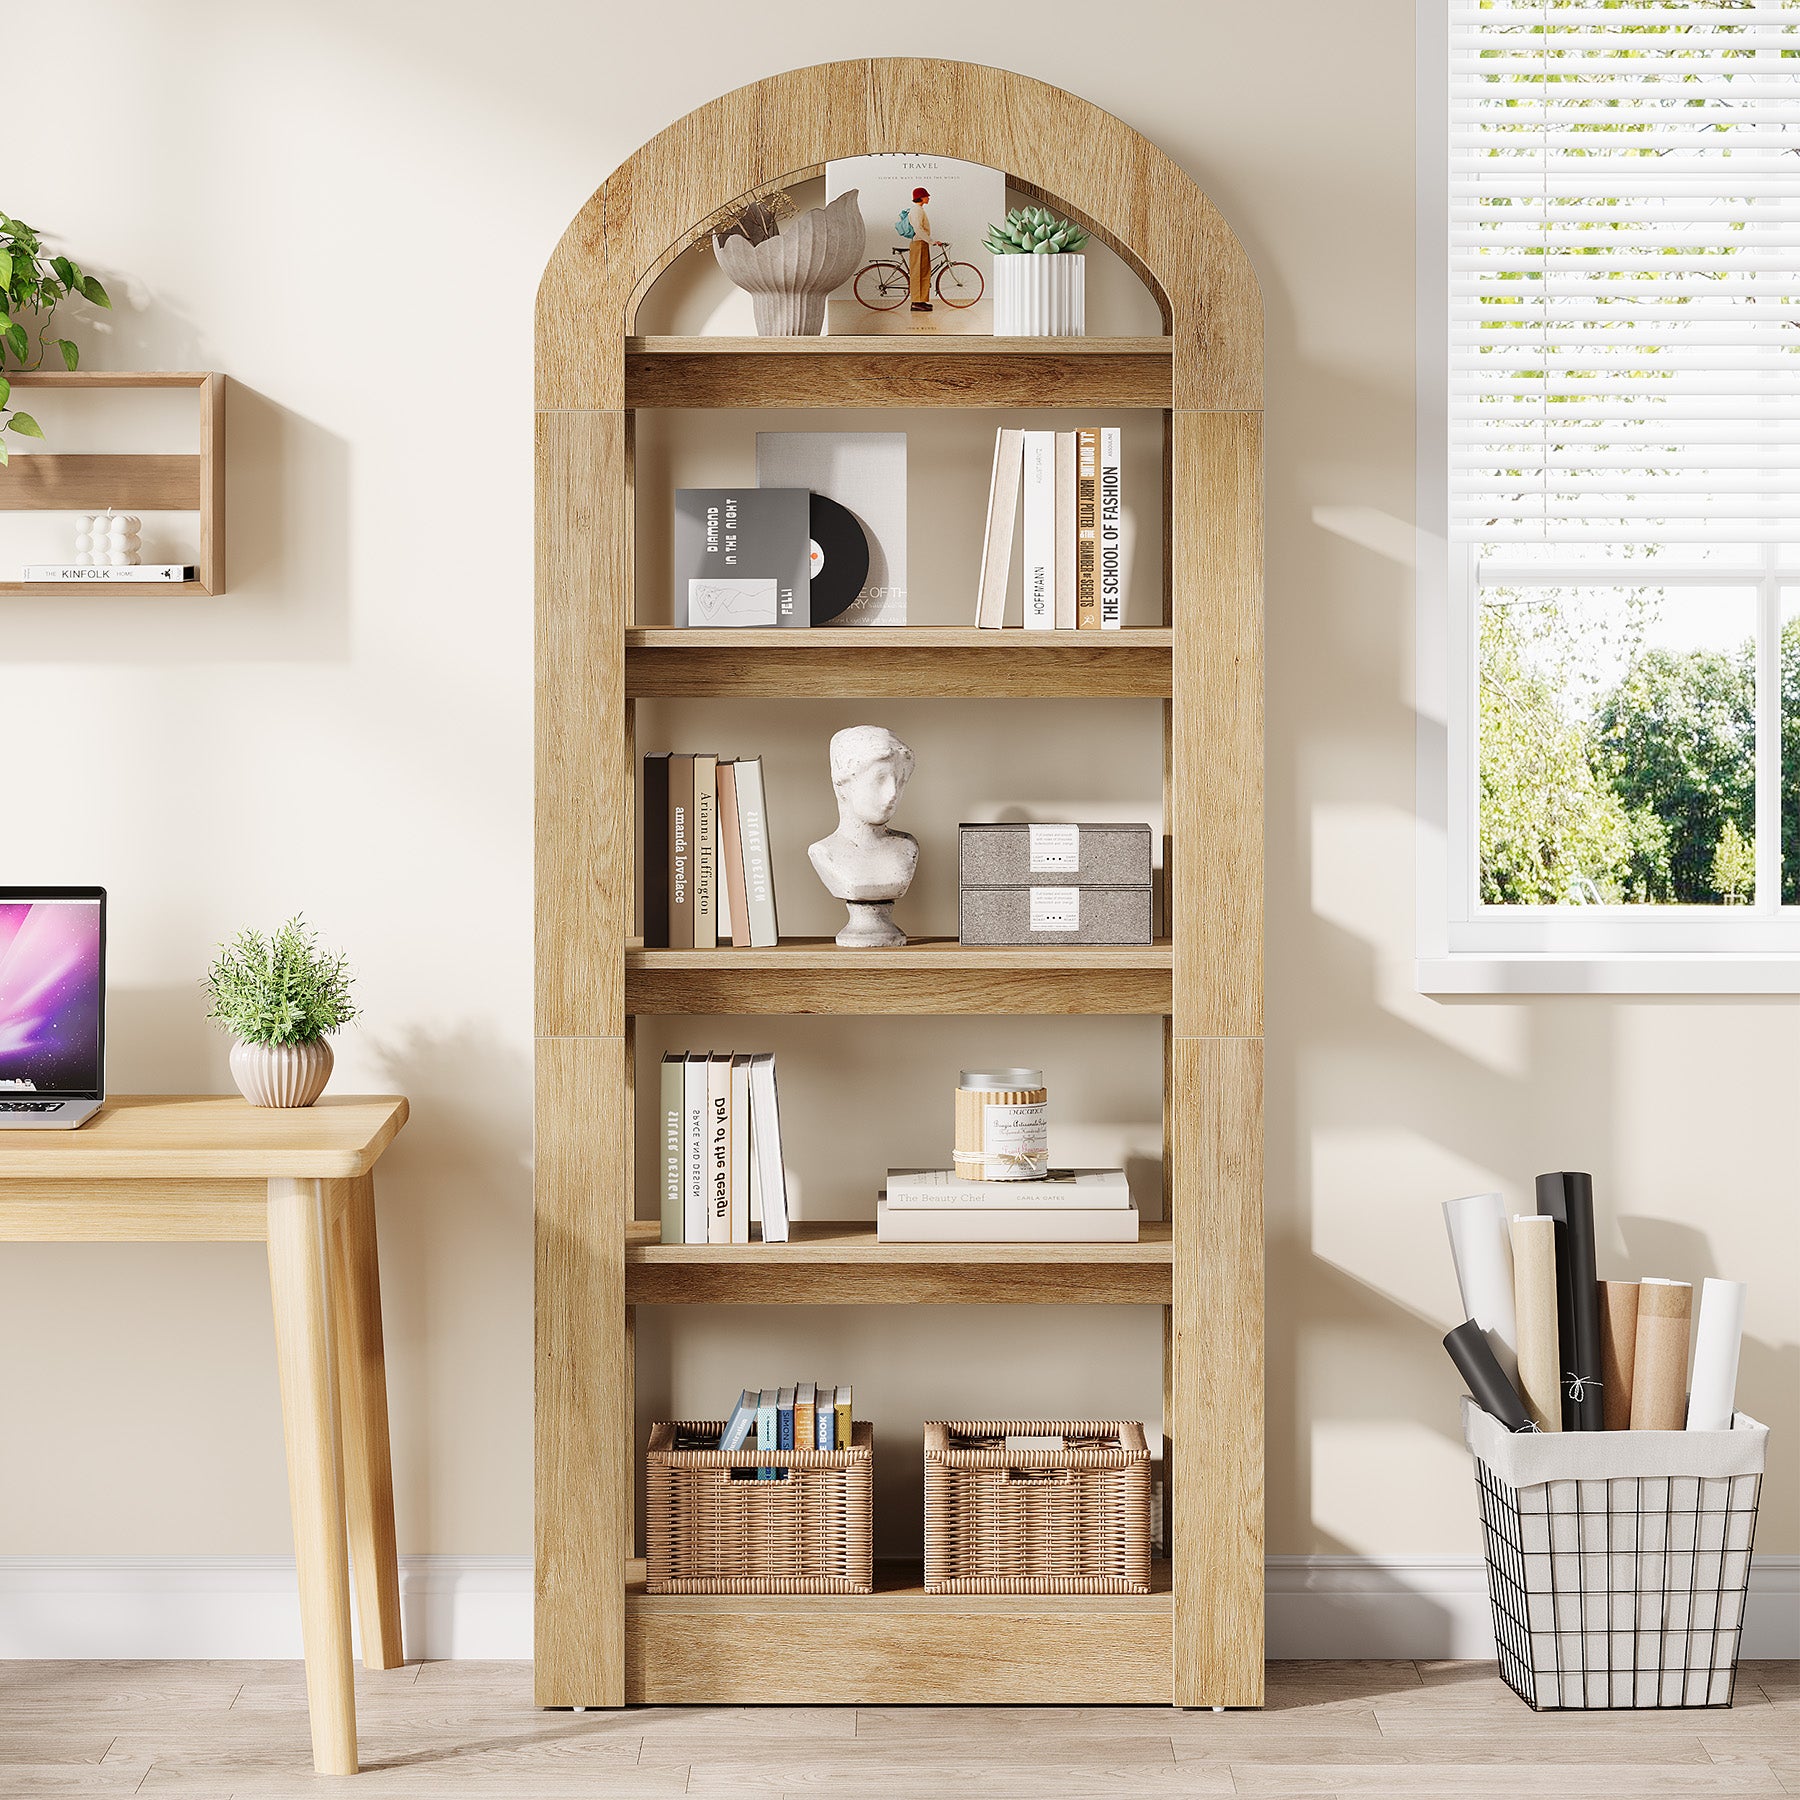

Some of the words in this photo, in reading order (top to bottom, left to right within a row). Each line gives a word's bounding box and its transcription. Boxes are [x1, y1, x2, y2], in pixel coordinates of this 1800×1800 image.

[1080, 431, 1094, 446] J.K.
[1080, 480, 1094, 502] HARRY
[1103, 466, 1118, 520] FASHION
[1080, 503, 1094, 528] POTTER
[707, 507, 718, 552] DIAMOND
[1103, 524, 1118, 540] OF
[726, 535, 737, 552] THE
[1080, 540, 1094, 572] CHAMBER
[62, 570, 110, 578] KINFOLK
[1103, 544, 1118, 594] SCHOOL
[781, 588, 792, 615] FELLI
[870, 586, 888, 598] OF
[1034, 566, 1044, 615] HOFFMANN
[1080, 580, 1094, 607] SECRETS
[1103, 598, 1118, 622] THE
[676, 807, 687, 853] amanda
[700, 792, 712, 841] Arianna
[676, 856, 687, 903] lovelace
[697, 847, 712, 915] Huffington
[898, 1193, 918, 1202] The
[921, 1193, 956, 1204] Beauty
[960, 1193, 986, 1202] Chef
